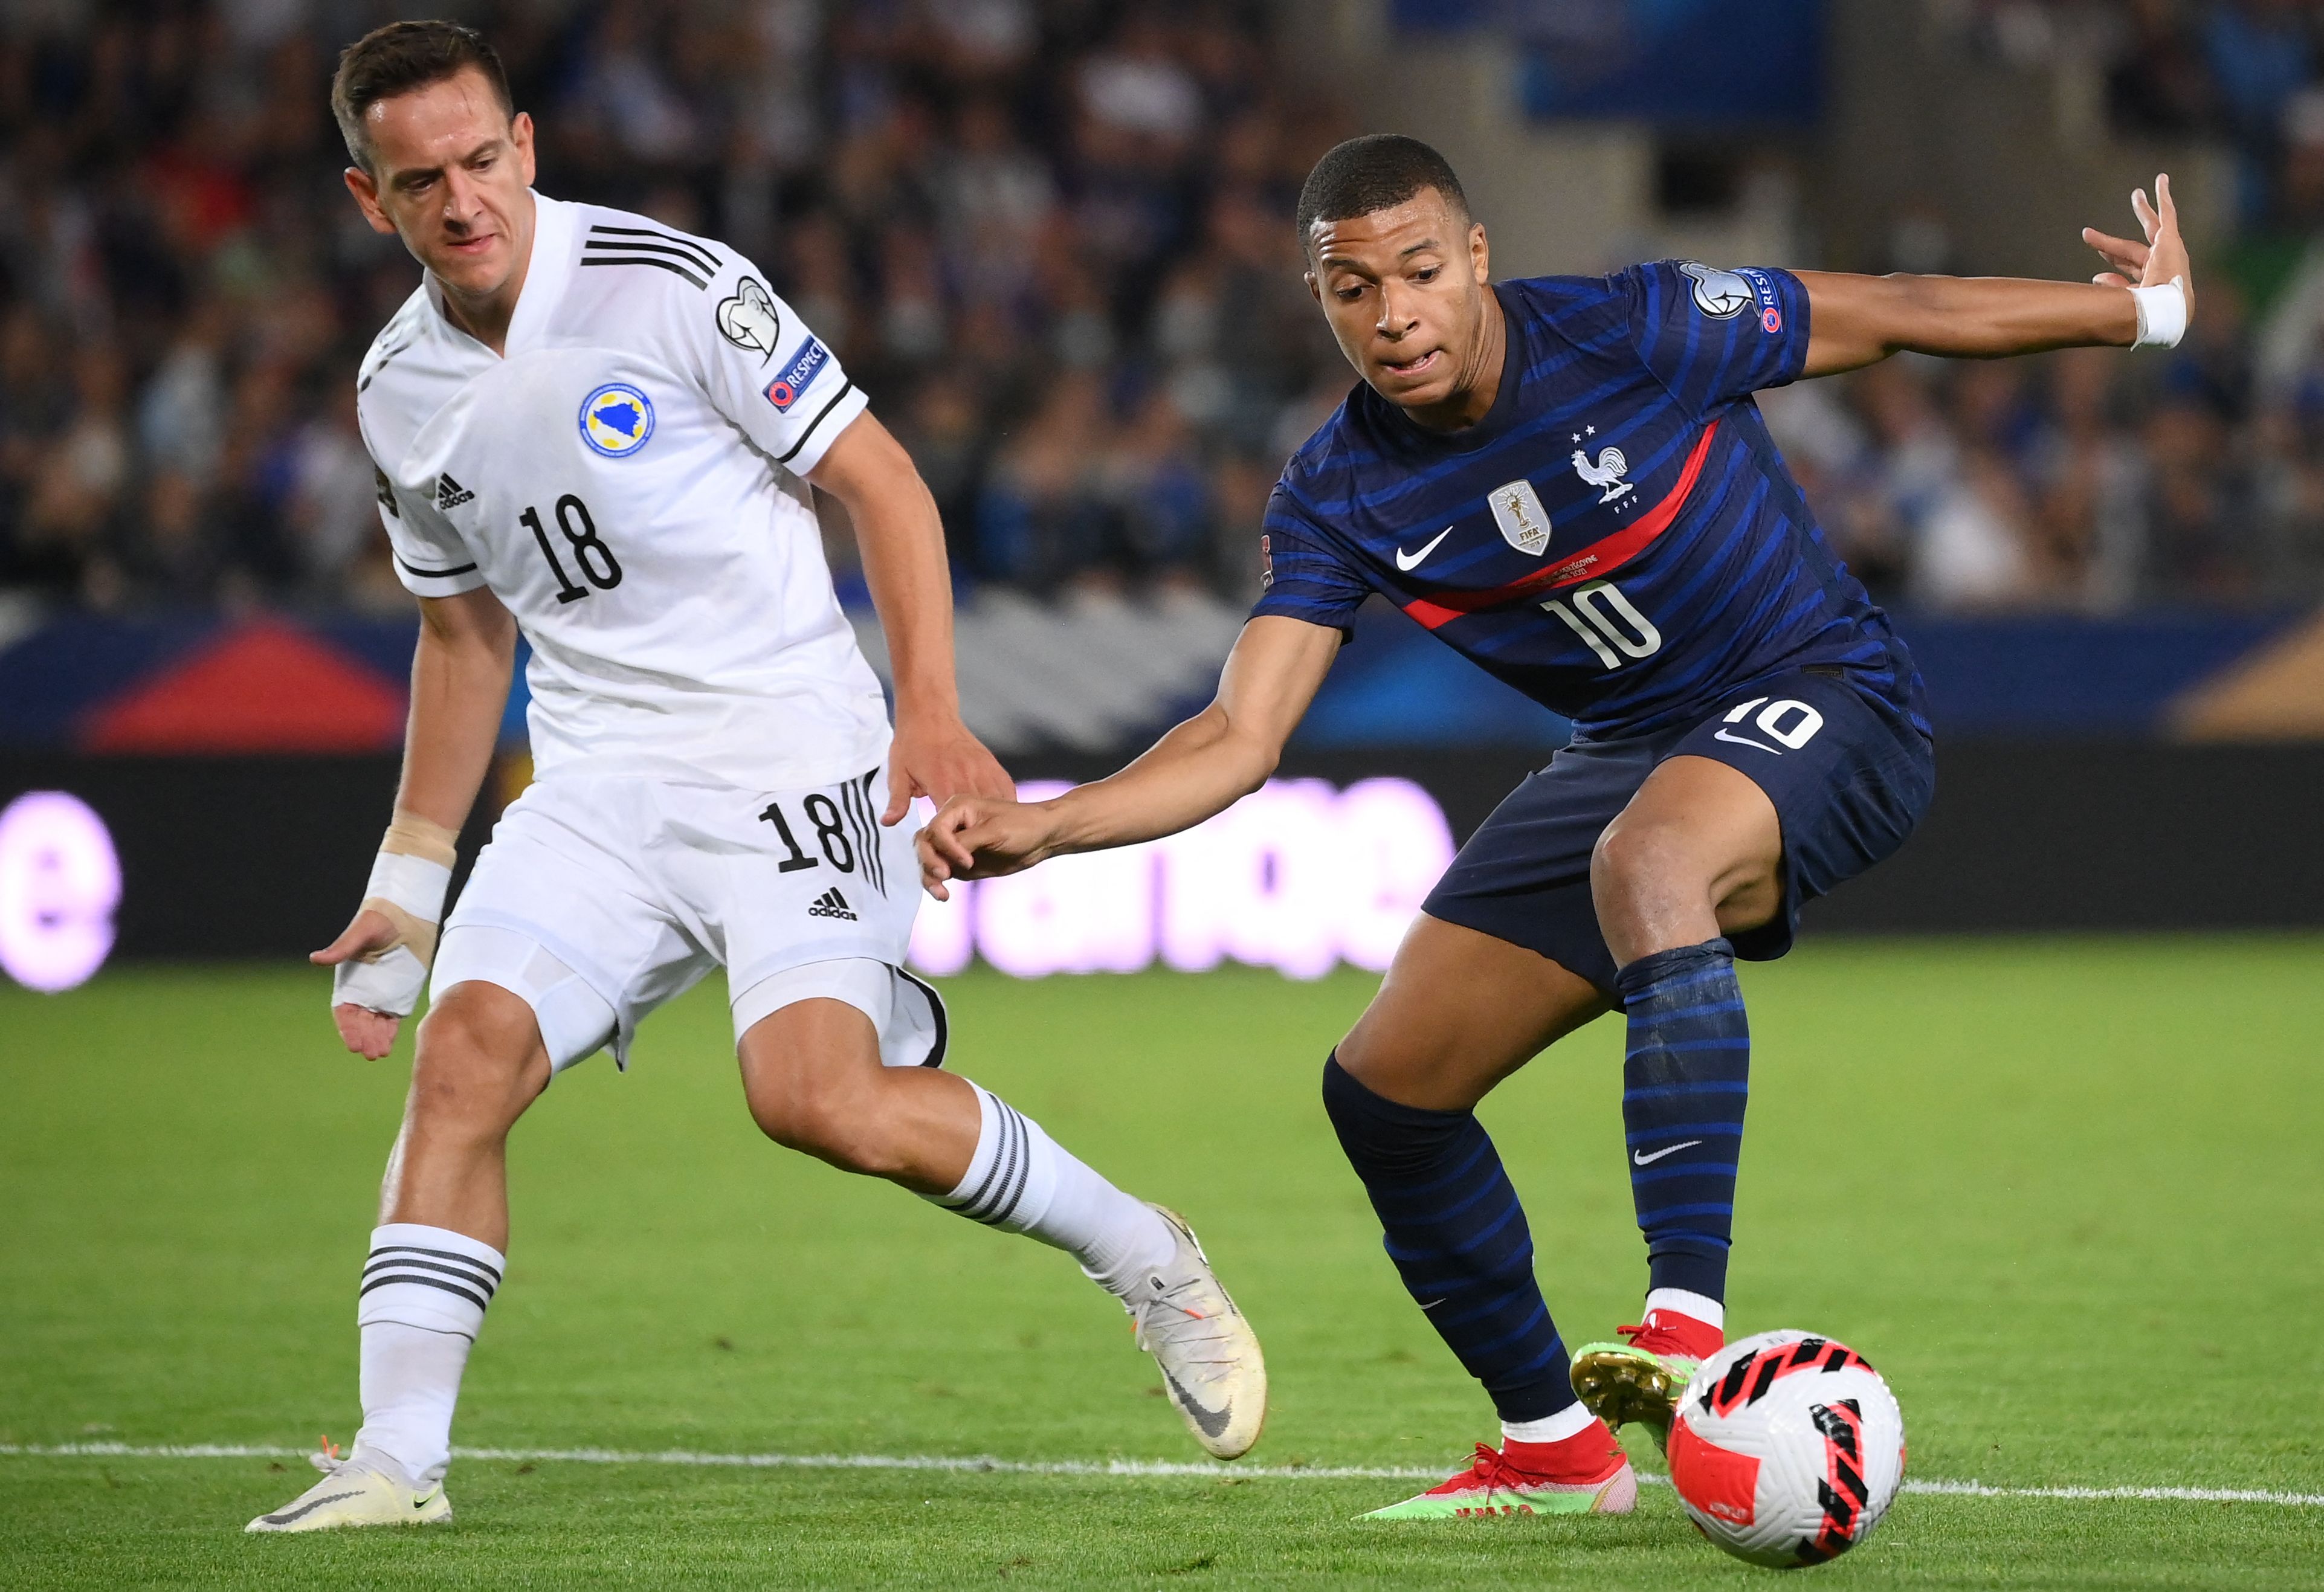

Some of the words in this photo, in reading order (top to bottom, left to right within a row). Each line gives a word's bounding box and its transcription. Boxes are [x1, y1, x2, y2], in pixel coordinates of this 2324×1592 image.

[439, 491, 475, 510] adidas
[518, 494, 622, 604] 18
[1519, 527, 1540, 541] FIFA
[1539, 580, 1661, 669] 10
[1722, 697, 1824, 750] 10
[758, 794, 854, 873] 18
[808, 906, 858, 921] adidas
